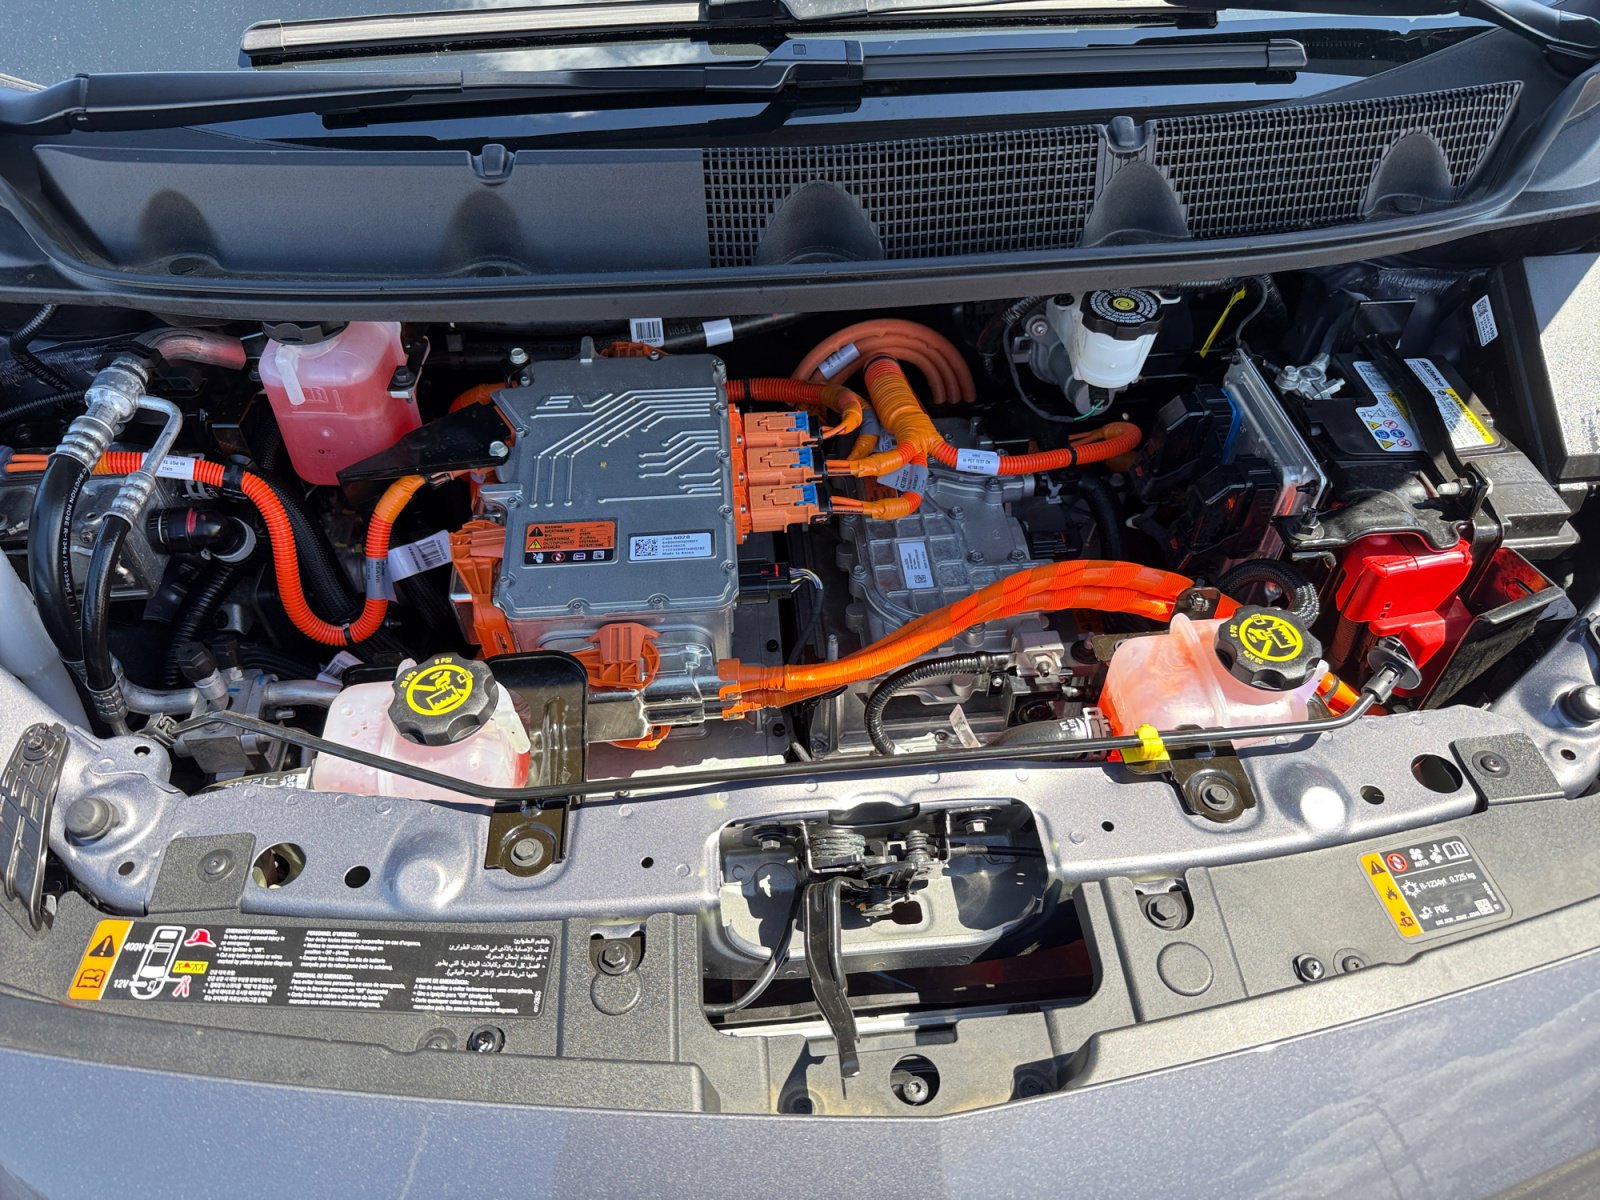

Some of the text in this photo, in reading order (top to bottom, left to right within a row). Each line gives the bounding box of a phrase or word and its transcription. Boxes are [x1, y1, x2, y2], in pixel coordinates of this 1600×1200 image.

[68, 472, 84, 504] SUCTION
[64, 504, 73, 526] HOSE
[1415, 859, 1430, 868] AUTO
[1419, 878, 1447, 890] R-1234yf
[1435, 904, 1449, 914] POE
[124, 942, 144, 951] 400V
[113, 979, 130, 989] 12V
